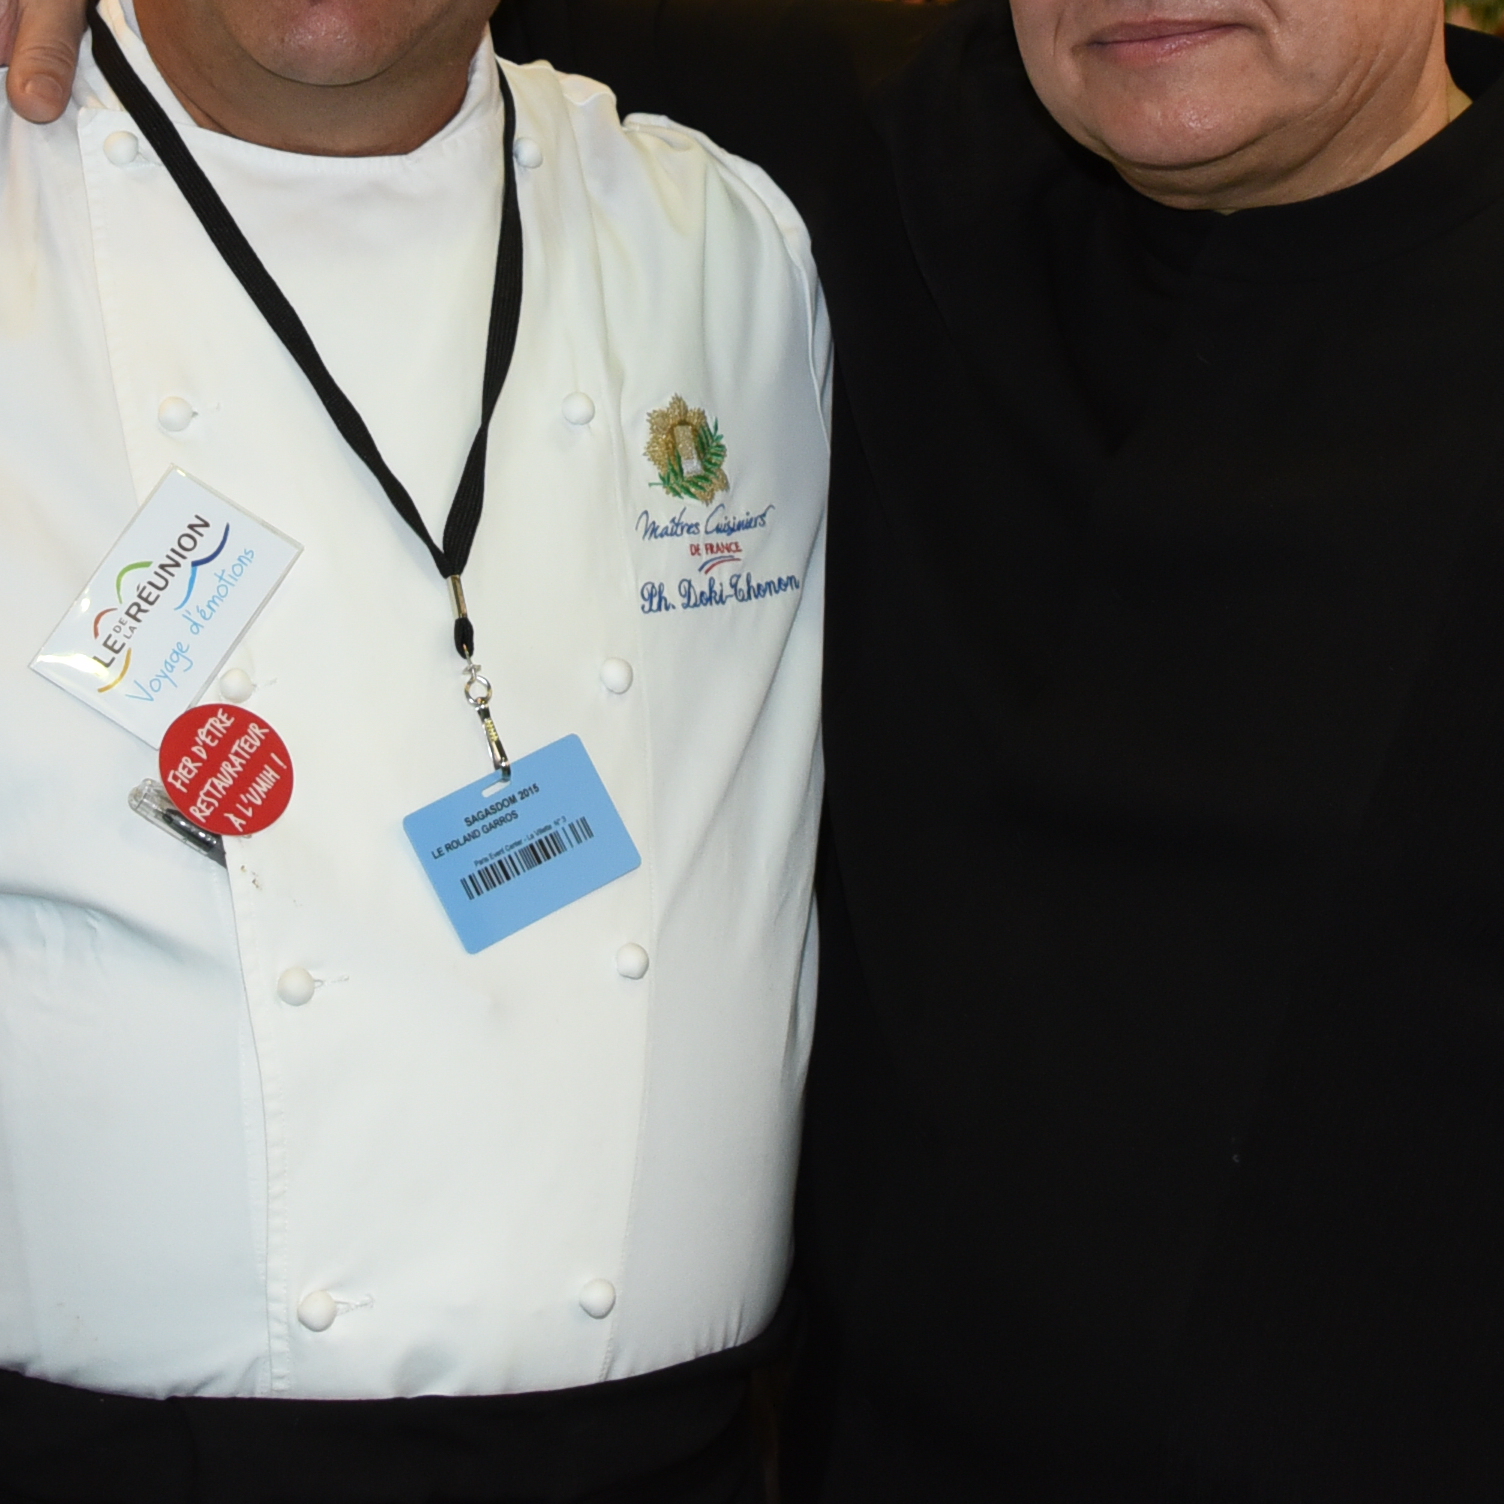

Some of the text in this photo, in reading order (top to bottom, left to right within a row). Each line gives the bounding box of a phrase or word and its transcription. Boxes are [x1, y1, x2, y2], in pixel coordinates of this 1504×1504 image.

[635, 506, 700, 541] Maîtres
[124, 514, 211, 623] RÉUNION
[689, 541, 743, 556] DE FRANCE
[640, 580, 676, 614] Ph.
[112, 617, 127, 634] DE
[123, 625, 136, 640] LA
[125, 545, 255, 703] Voyage d'émotions
[167, 708, 235, 794] FIER D'ÊTRE
[189, 722, 269, 822] RESTAURATEUR
[240, 768, 280, 818] L'UMIH
[464, 783, 540, 827] SAGASDOM 2015
[431, 810, 519, 860] LE ROLAND GARROS
